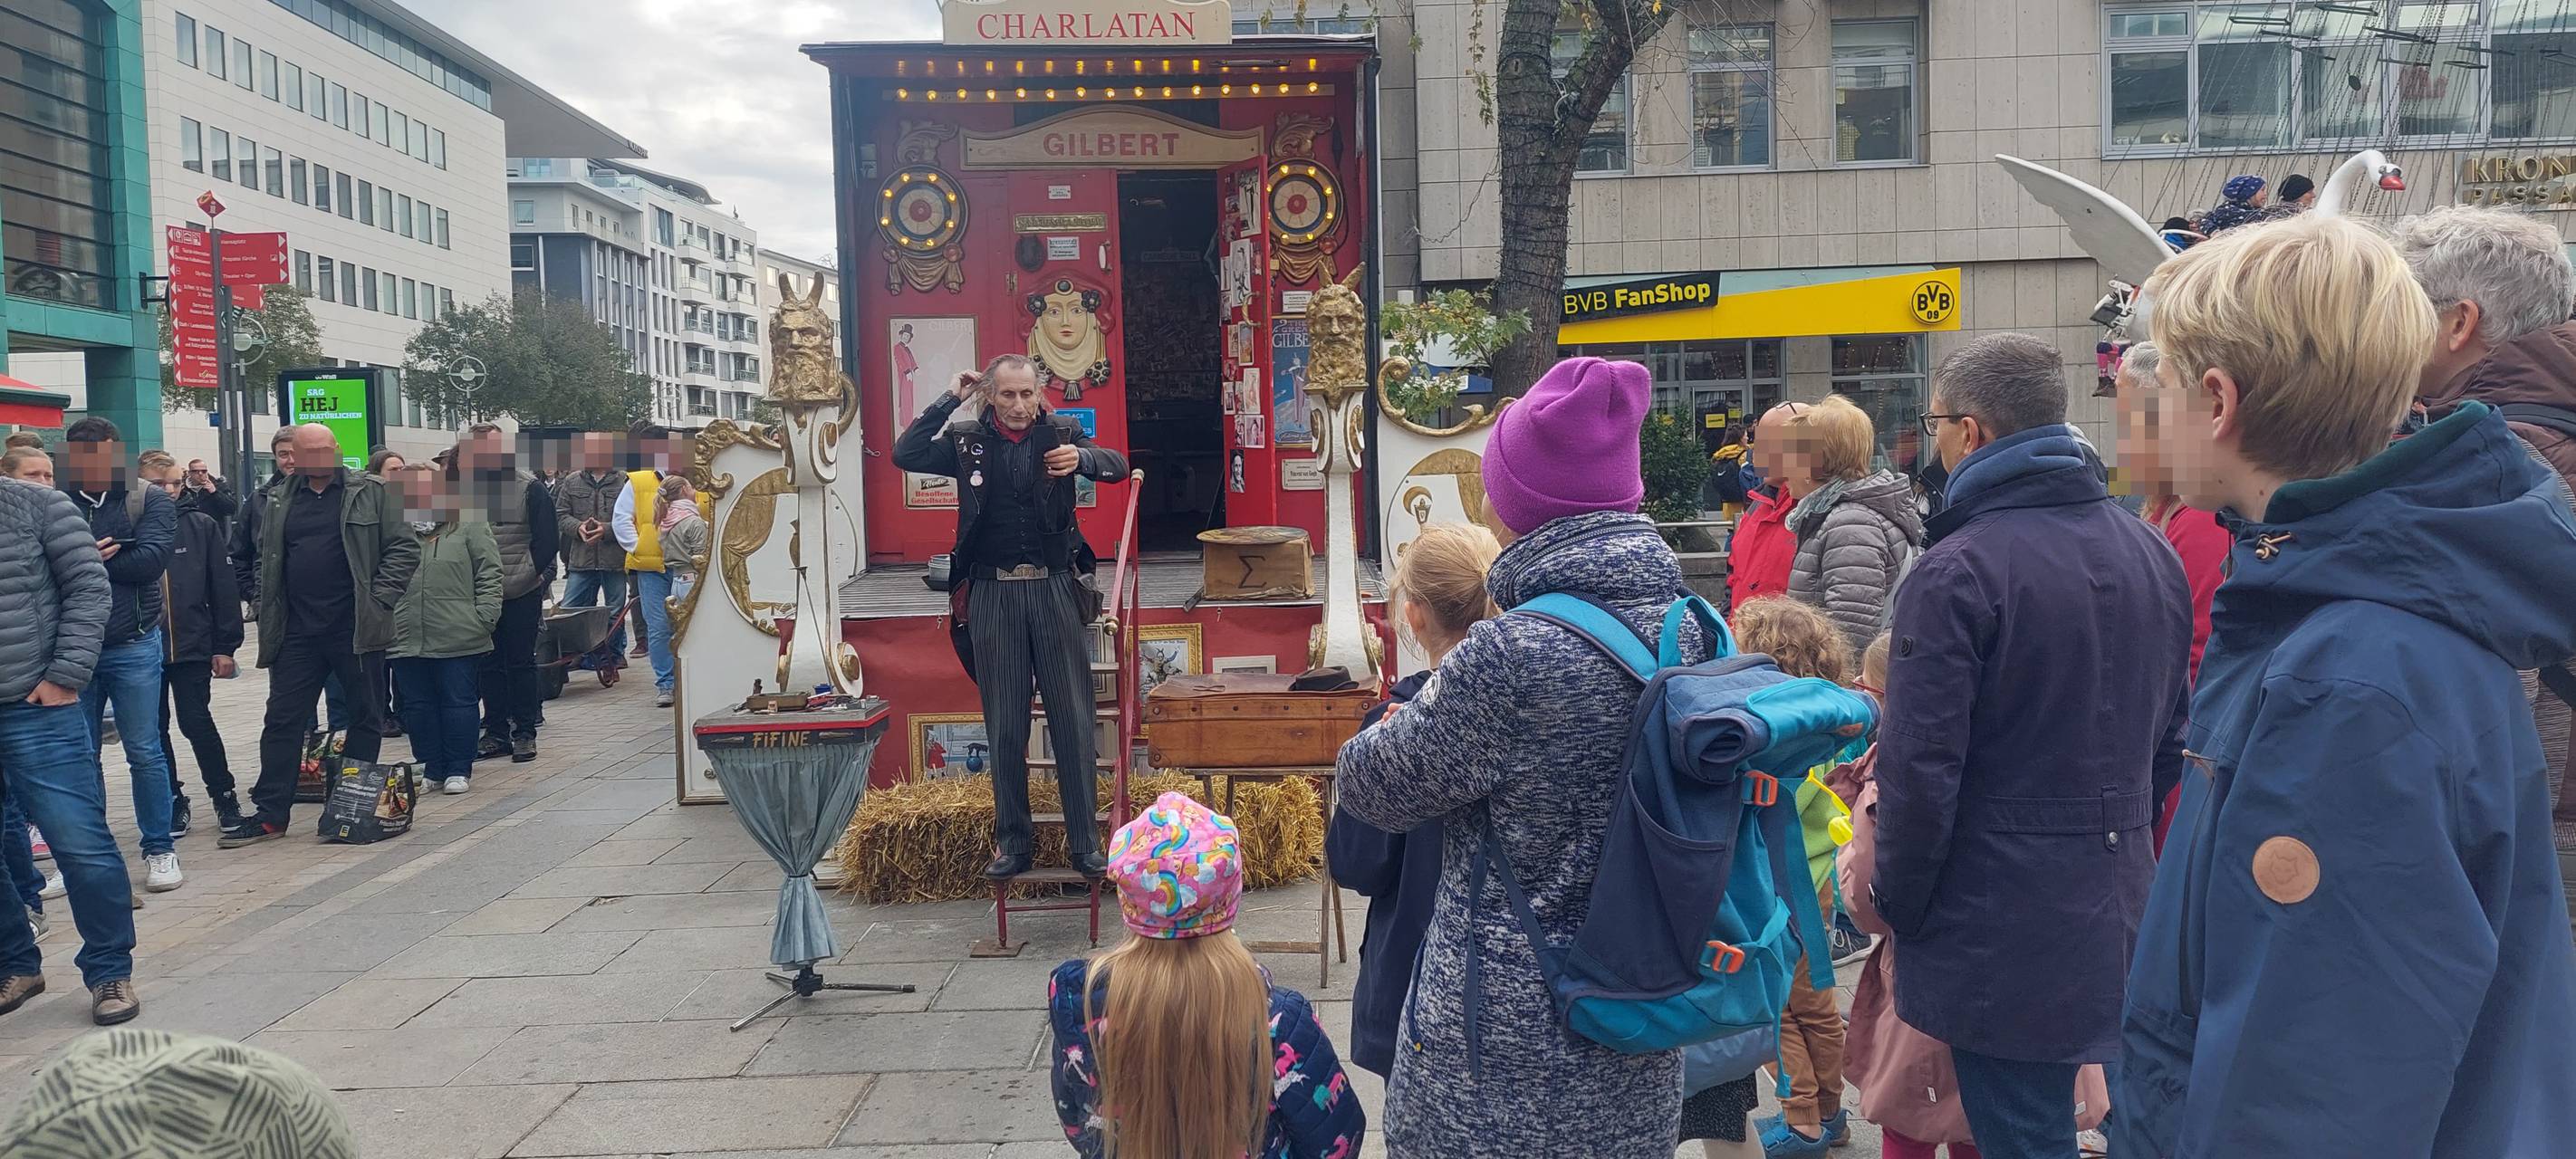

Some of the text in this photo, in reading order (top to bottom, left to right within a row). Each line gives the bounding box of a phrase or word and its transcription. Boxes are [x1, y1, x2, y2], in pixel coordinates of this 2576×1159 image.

[976, 11, 1196, 39] CHARLATAN
[1043, 133, 1180, 156] GILBERT
[1563, 283, 1711, 315] BVB FanShop
[1917, 284, 1950, 311] BVB
[1927, 310, 1939, 320] 09
[306, 388, 325, 397] SAG
[300, 397, 339, 412] HEJ
[310, 411, 362, 419] NATÜRLICHEN
